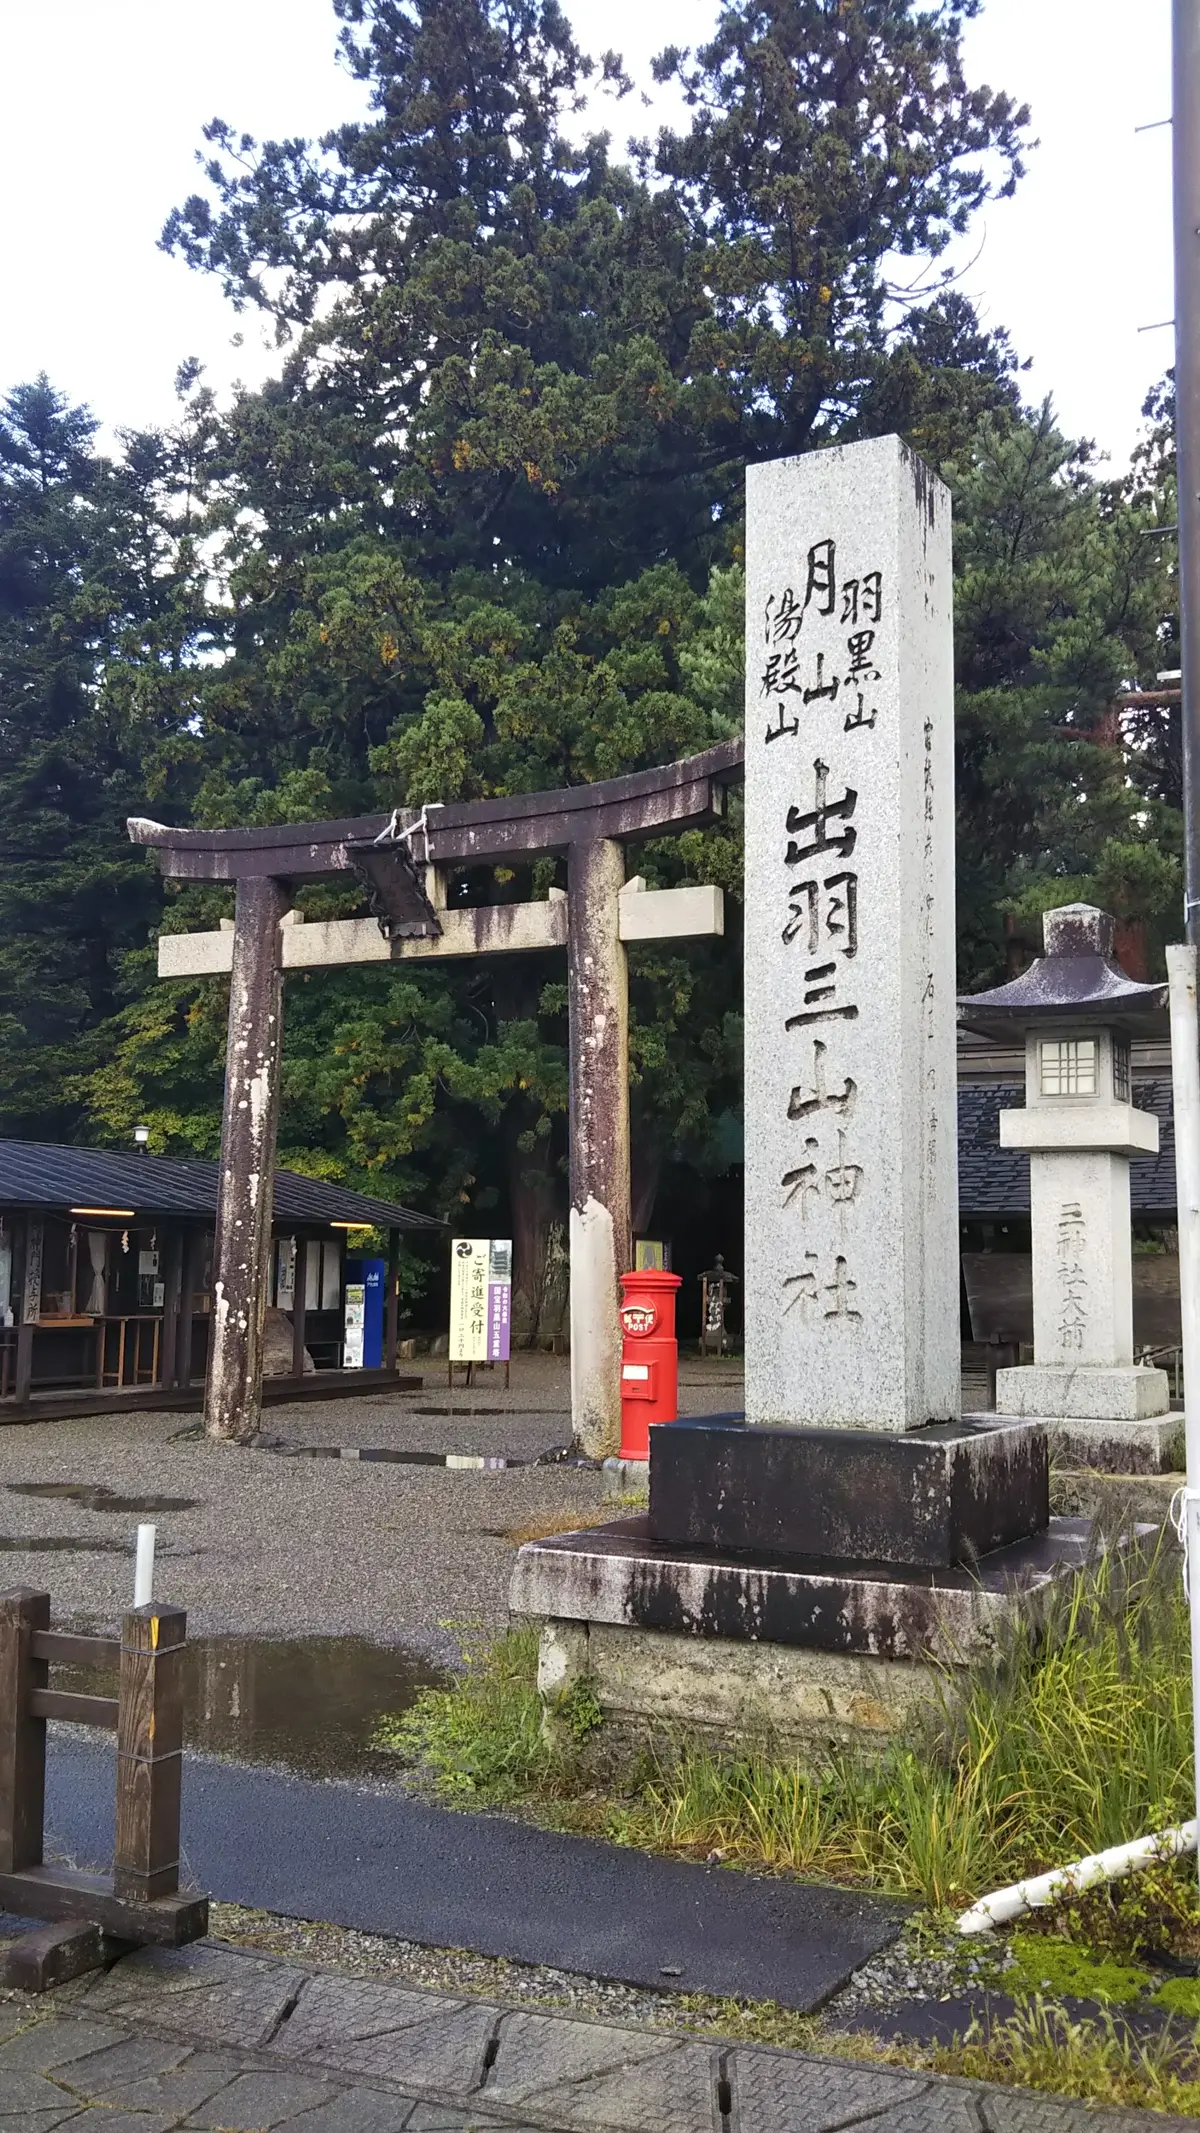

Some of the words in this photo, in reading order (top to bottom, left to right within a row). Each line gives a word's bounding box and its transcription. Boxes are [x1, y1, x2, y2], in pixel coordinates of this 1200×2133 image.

[760, 588, 803, 744] 湯殿山
[803, 538, 839, 705] 月山
[840, 571, 883, 733] 羽黒山
[782, 757, 865, 1324] 出羽三山神社
[470, 1253, 487, 1335] ご寄進受付
[628, 1323, 648, 1331] POST
